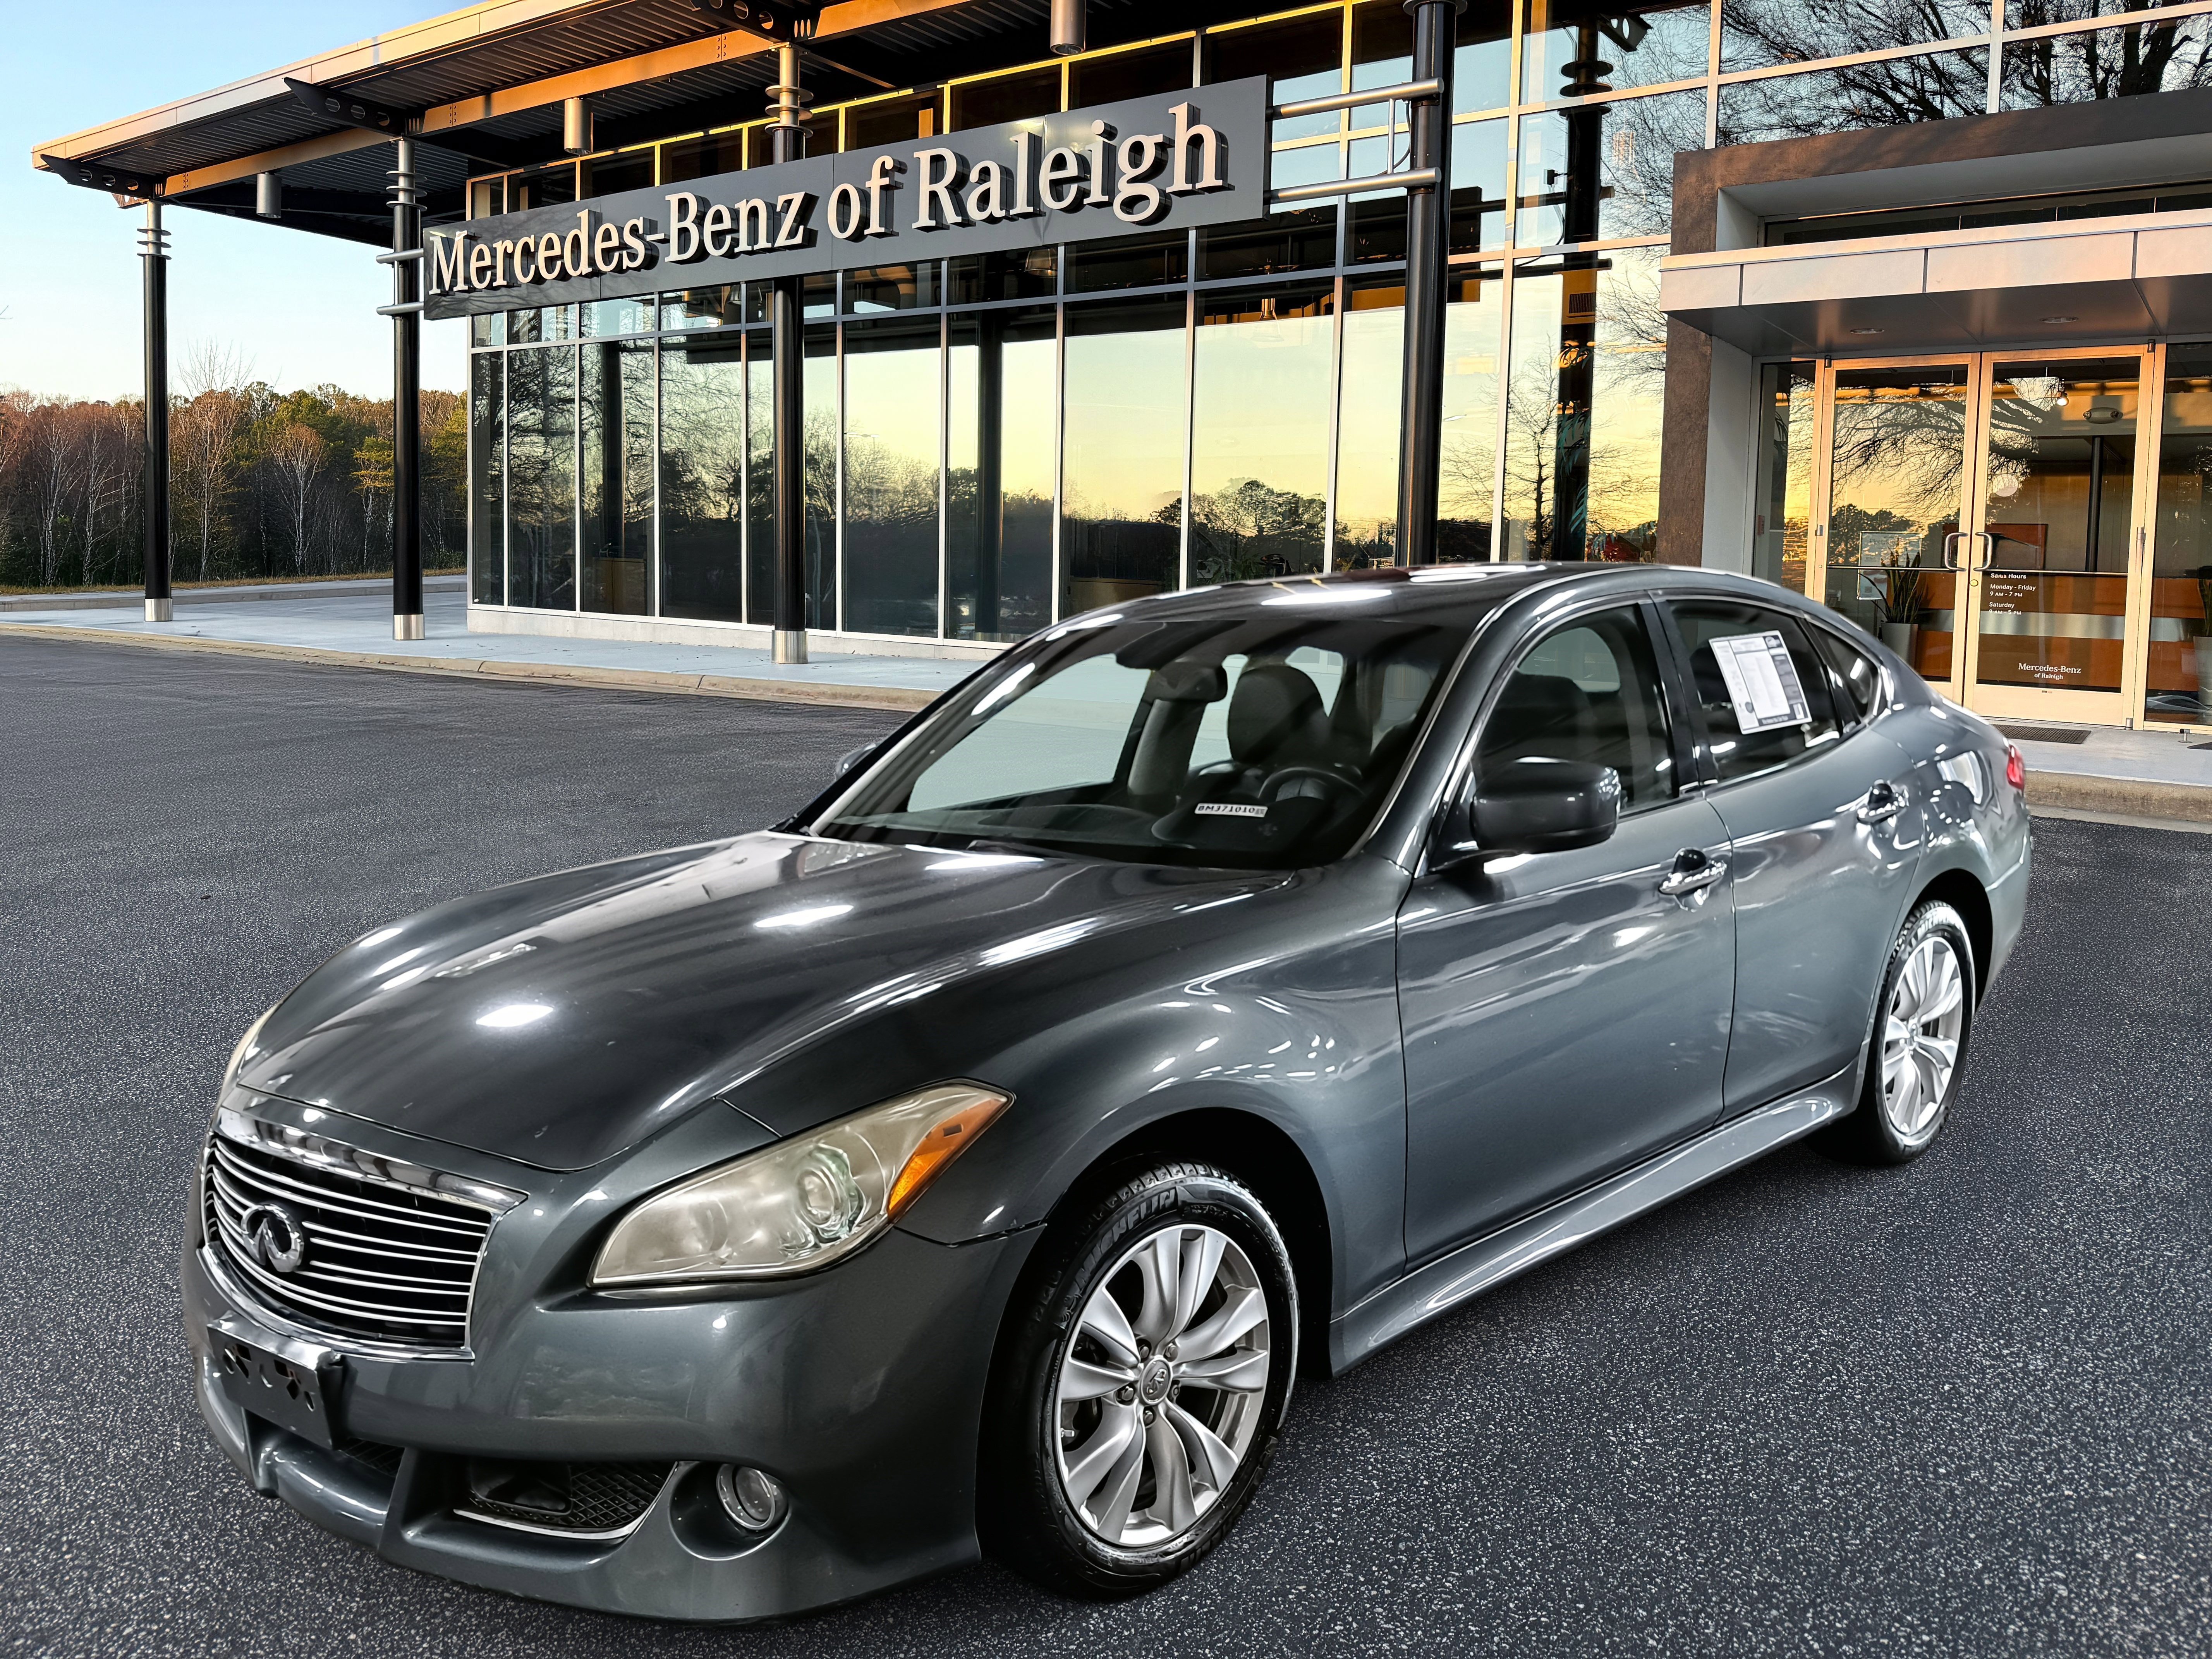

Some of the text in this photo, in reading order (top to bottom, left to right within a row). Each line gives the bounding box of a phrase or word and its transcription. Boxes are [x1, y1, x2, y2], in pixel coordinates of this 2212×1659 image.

[428, 101, 1223, 295] Mercedes-Benz of Raleigh
[2018, 663, 2081, 674] Mercedes-Benz
